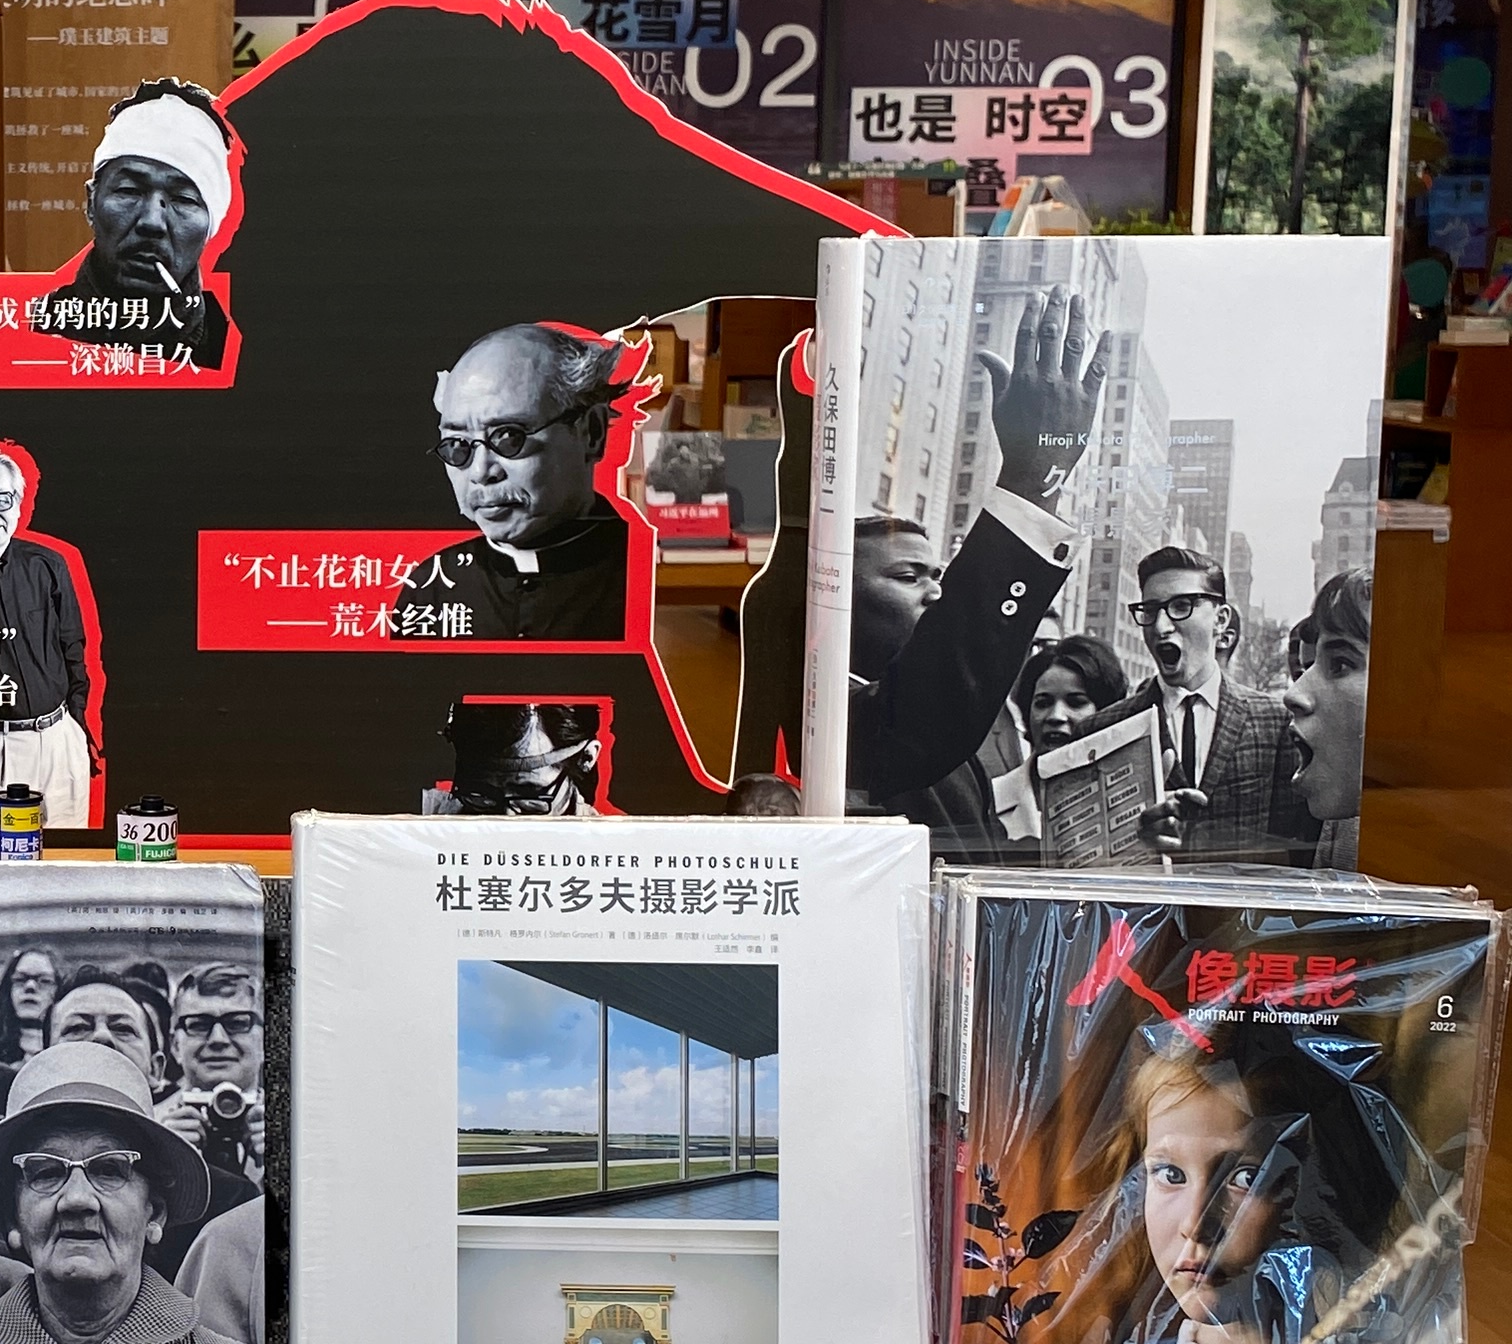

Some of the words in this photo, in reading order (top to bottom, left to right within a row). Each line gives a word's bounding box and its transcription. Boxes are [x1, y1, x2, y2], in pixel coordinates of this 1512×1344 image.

[934, 39, 1021, 62] INSIDE
[684, 23, 817, 108] 02
[924, 62, 1035, 85] YUNNAN
[1038, 55, 1168, 140] 03
[855, 94, 957, 145] 也是
[986, 94, 1088, 143] 时空
[820, 362, 840, 514] 久保田博二
[1039, 433, 1074, 450] Hiroji
[224, 552, 475, 590] “不止花和女人”
[267, 602, 474, 640] ——荒木经惟
[0, 835, 40, 853] 柯尼卡
[120, 821, 138, 841] 36
[143, 821, 178, 842] 200
[437, 852, 471, 868] DIE
[483, 851, 641, 869] DÜSSELDORFER
[654, 854, 802, 871] PHOTOSCHULE
[435, 875, 802, 918] 杜塞尔多夫摄影学派
[1066, 920, 1358, 1053] 人像摄影
[1188, 1007, 1246, 1025] PORTRAIT
[1253, 1010, 1340, 1027] PHOTOGRAPHY
[1434, 994, 1455, 1020] 6
[1429, 1020, 1457, 1034] 2022
